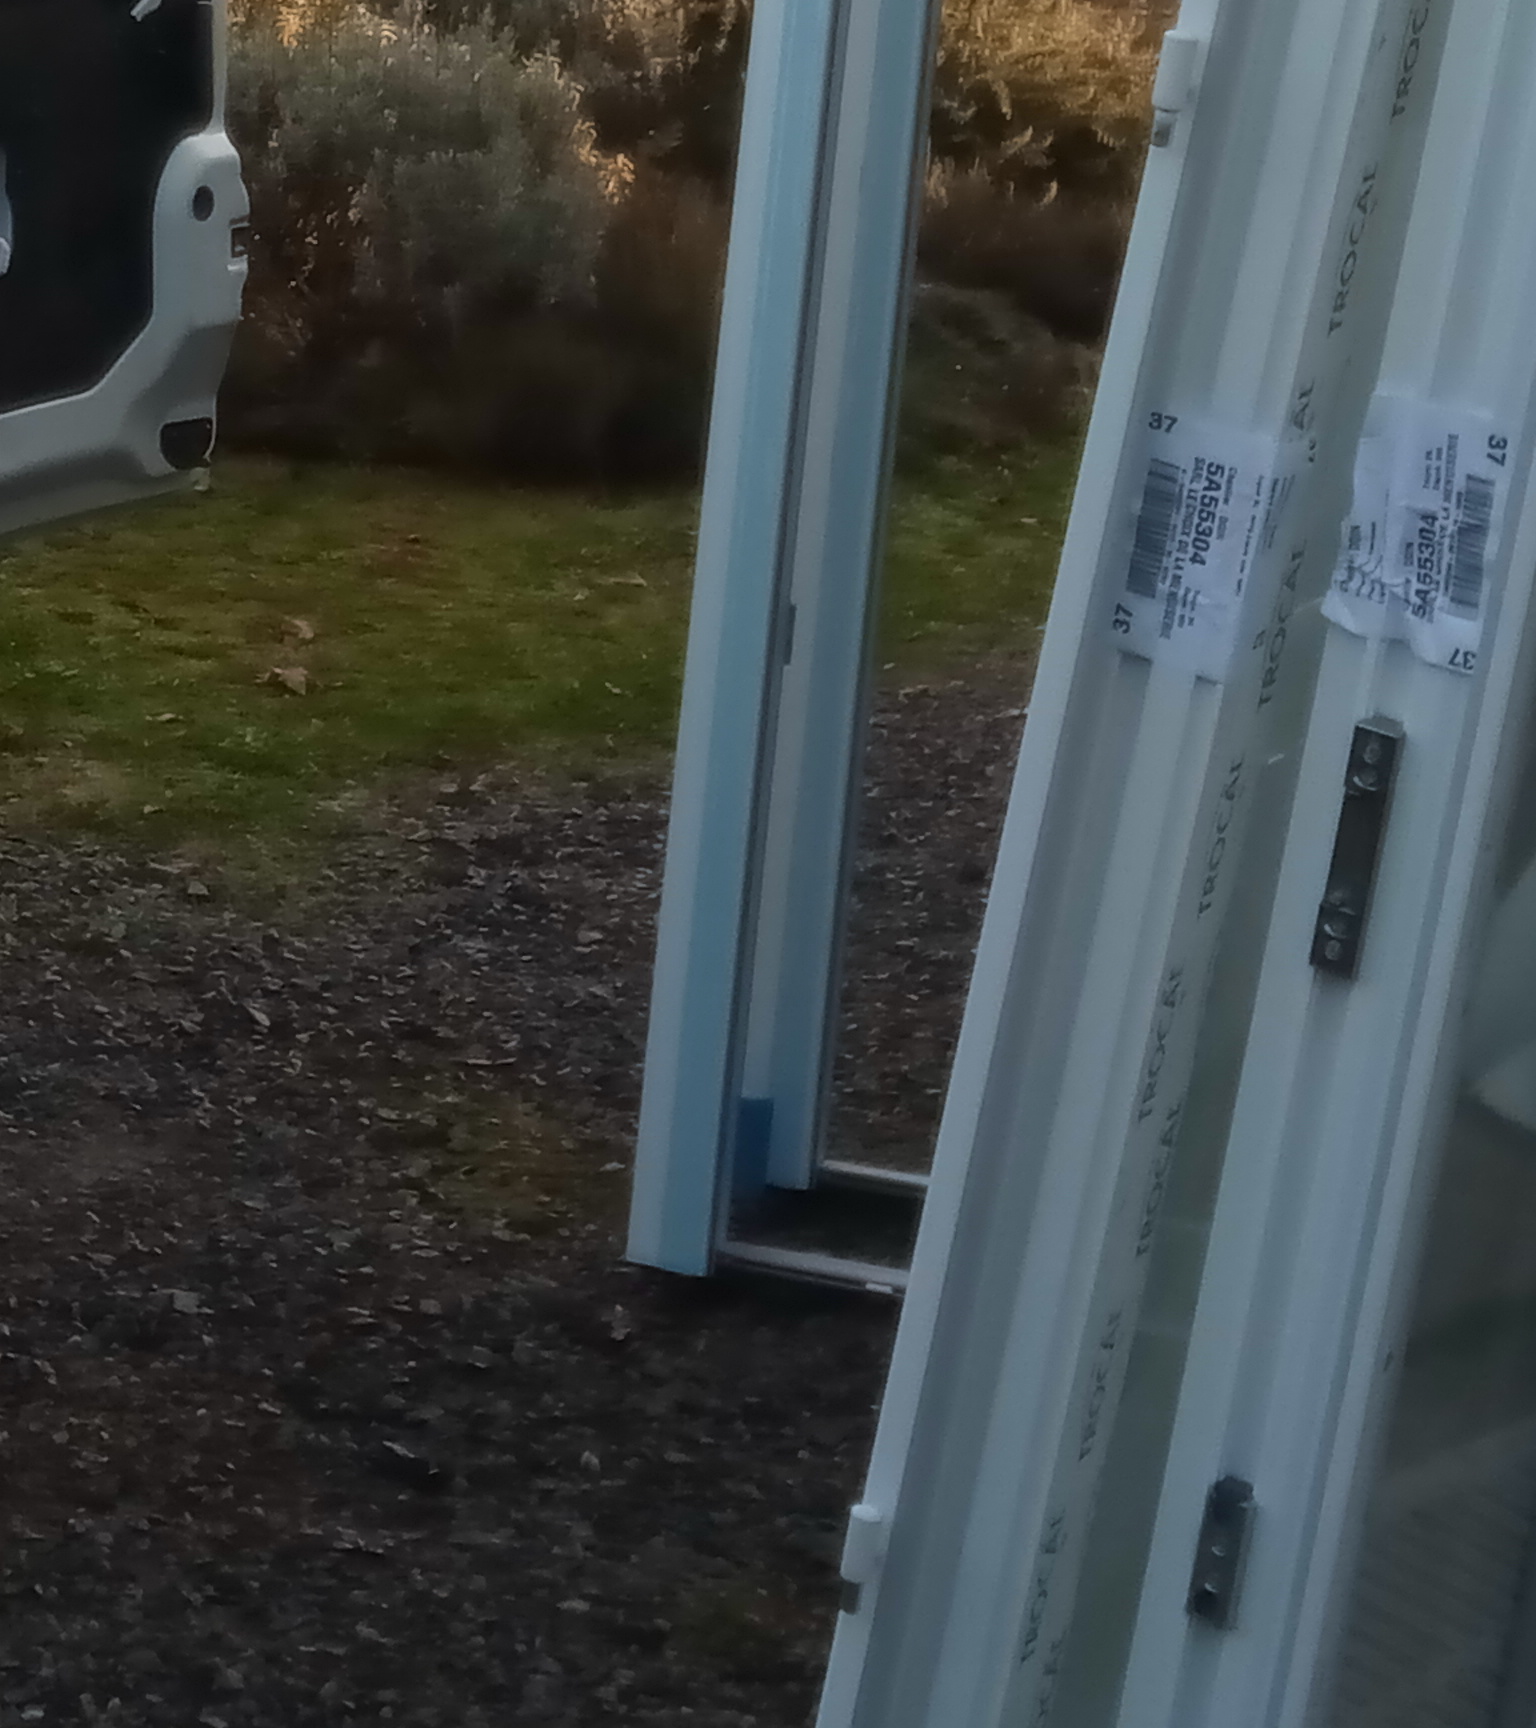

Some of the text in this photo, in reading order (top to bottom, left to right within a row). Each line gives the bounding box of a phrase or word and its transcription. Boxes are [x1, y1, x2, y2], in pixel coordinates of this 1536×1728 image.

[1328, 162, 1377, 338] TROCAL
[1148, 412, 1178, 433] 37
[1486, 434, 1508, 467] 37
[1187, 461, 1226, 565] 5A55304
[1410, 514, 1439, 617] 5A55304
[1112, 603, 1132, 633] 37
[1258, 538, 1307, 708] TROCAL
[1448, 648, 1476, 669] 37
[1197, 756, 1243, 920] TROCAL
